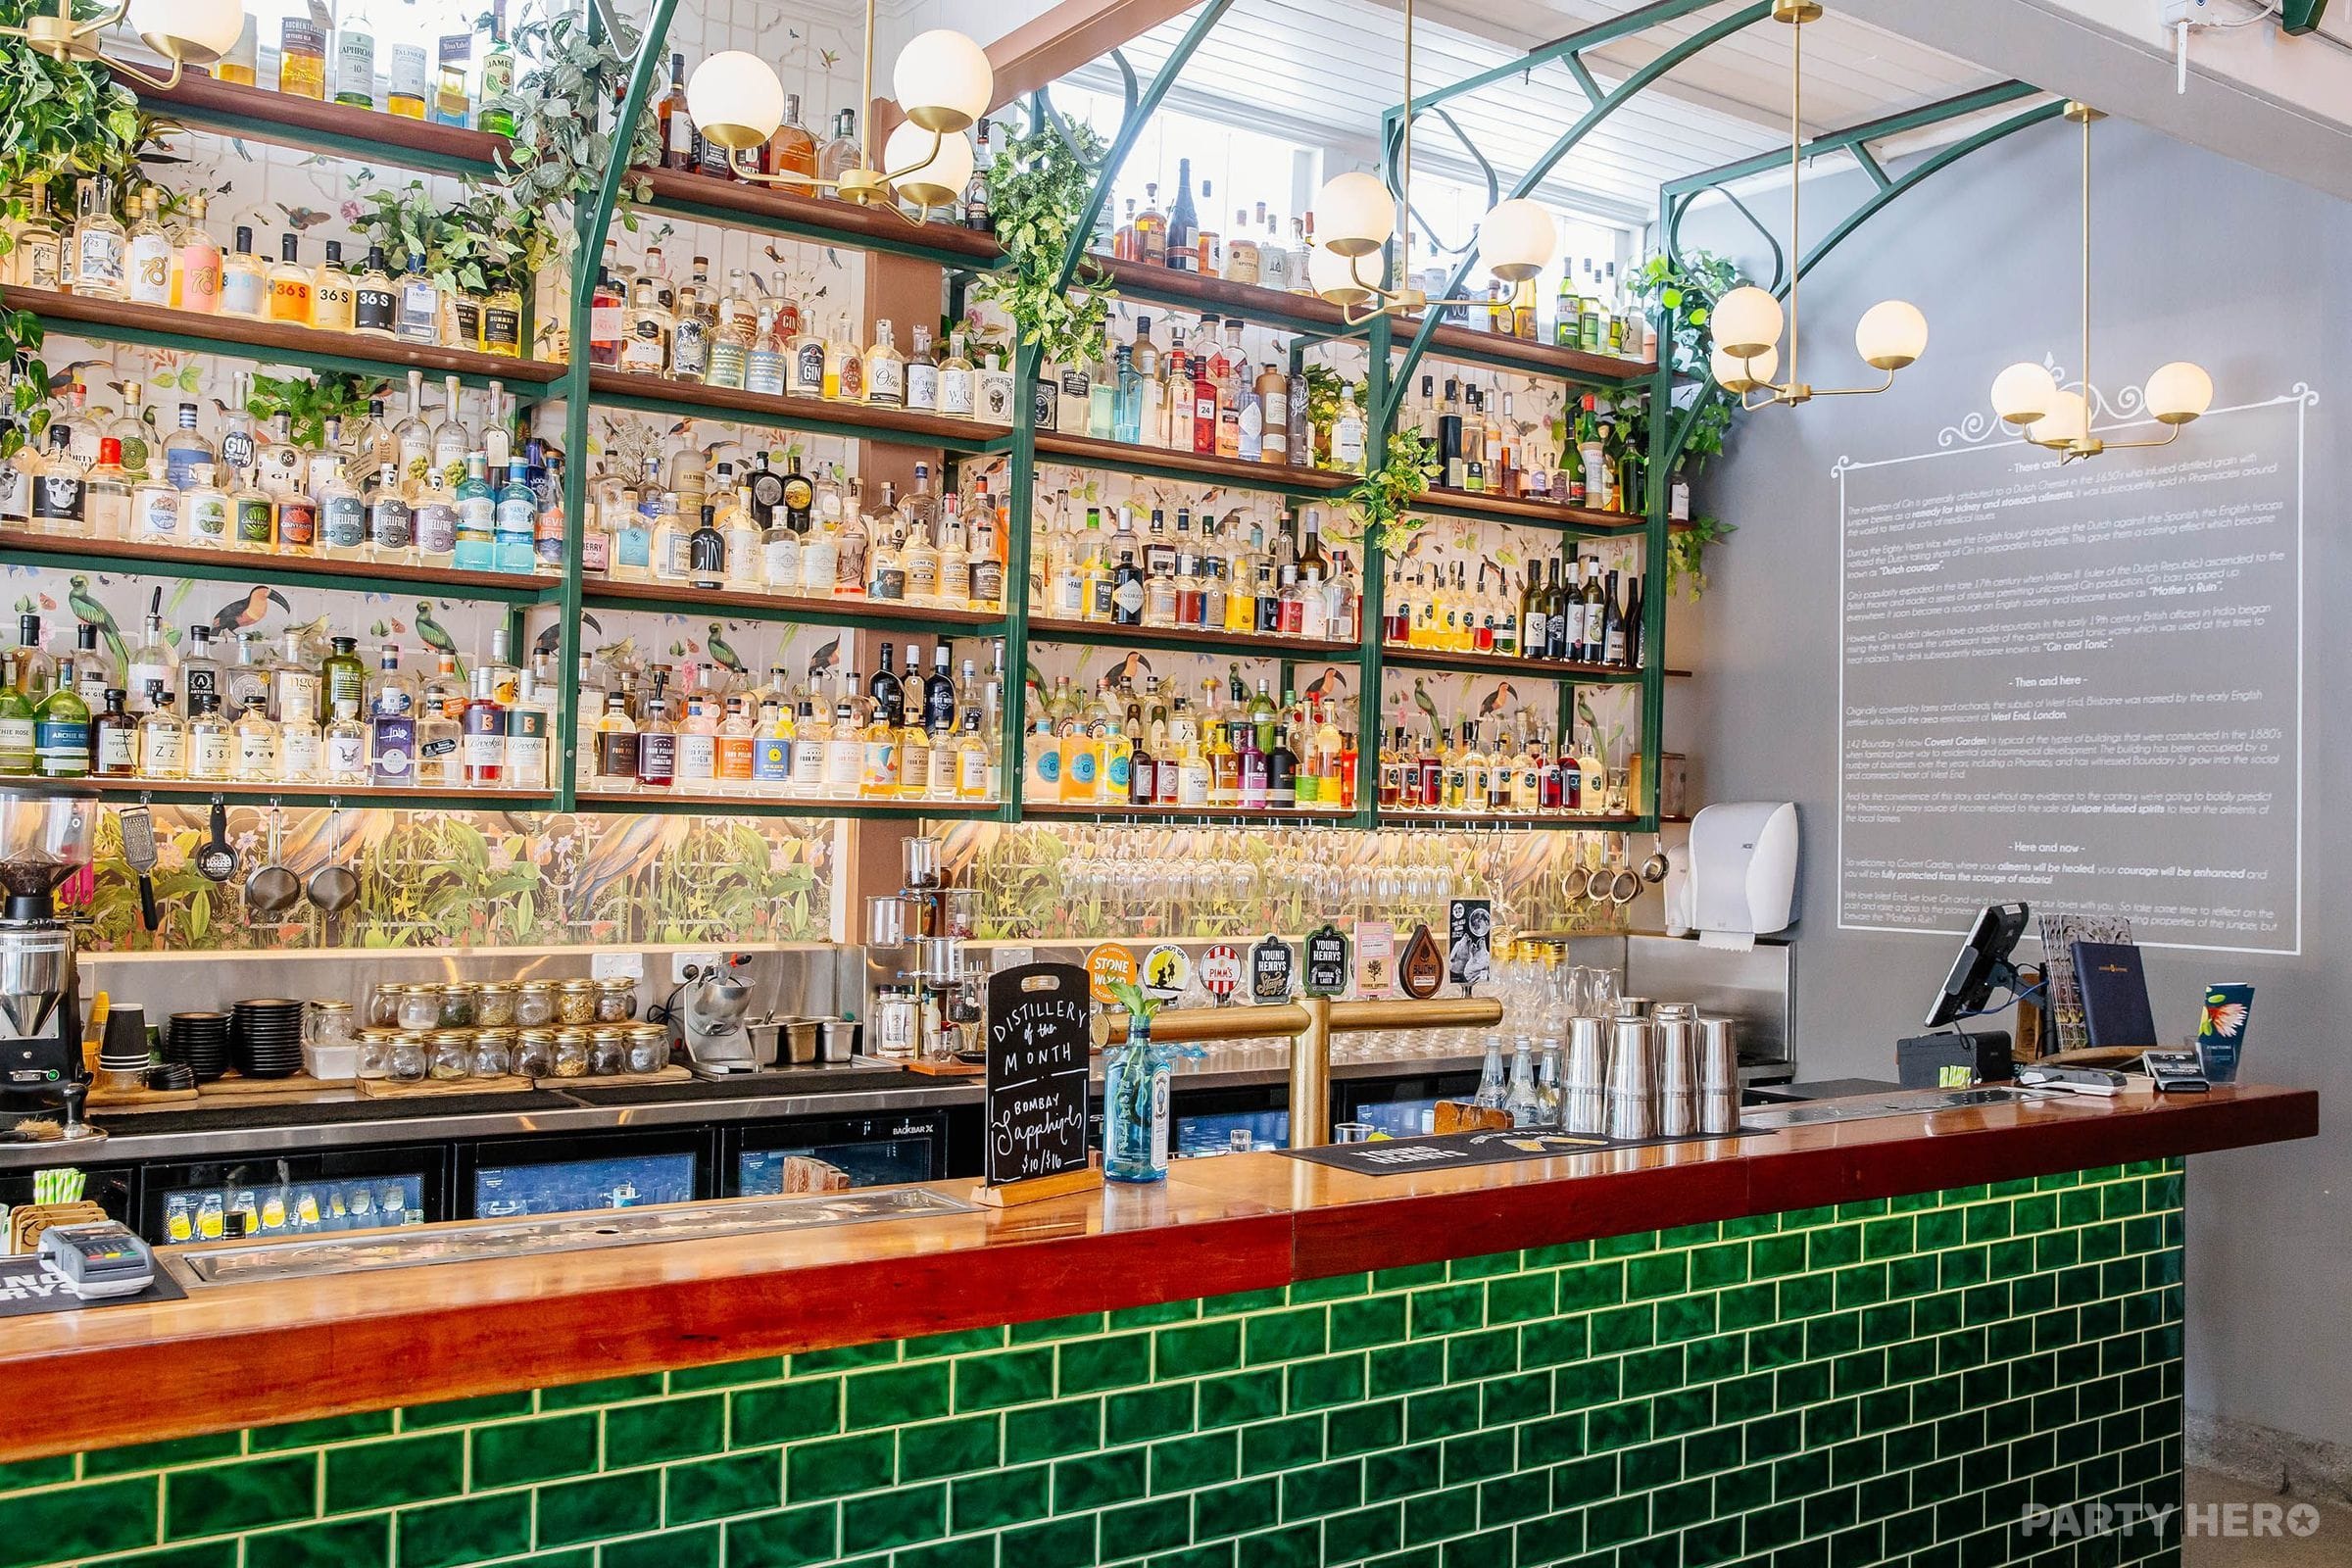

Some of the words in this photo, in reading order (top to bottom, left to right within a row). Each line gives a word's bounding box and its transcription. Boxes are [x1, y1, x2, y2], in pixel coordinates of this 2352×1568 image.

[276, 283, 296, 296] 36
[298, 286, 306, 298] S
[319, 289, 338, 302] 36
[341, 291, 349, 304] S
[359, 292, 378, 306] 36
[379, 294, 389, 307] S
[804, 365, 821, 382] GIN
[224, 436, 253, 457] GIN
[2014, 460, 2038, 473] There
[1911, 507, 1940, 519] remedy
[1941, 505, 1953, 514] for
[1954, 501, 1981, 514] kidney
[1982, 499, 2000, 509] and
[2001, 494, 2036, 507] stomach
[2218, 503, 2250, 516] English
[333, 514, 360, 527] HELLFIRE
[380, 514, 407, 529] HELLFIRE
[426, 519, 453, 532] HELLFIRE
[2234, 513, 2275, 526] became
[2204, 553, 2254, 566] ascended
[2268, 550, 2285, 561] the
[2237, 603, 2271, 615] began
[2063, 641, 2082, 651] and
[2015, 677, 2036, 686] Then
[2038, 676, 2057, 685] and
[2059, 675, 2081, 685] here
[480, 713, 494, 731] B
[1990, 712, 2011, 721] West
[523, 715, 535, 733] B
[1923, 737, 1954, 746] Covent
[2070, 804, 2102, 814] juniper
[2136, 805, 2165, 814] spirits
[2014, 842, 2036, 851] Here
[2038, 843, 2057, 852] and
[1997, 861, 2032, 871] ailments
[2033, 862, 2046, 871] will
[2046, 863, 2061, 872] be
[2117, 867, 2159, 876] courage
[2160, 866, 2176, 875] will
[2176, 867, 2191, 876] be
[2192, 867, 2246, 878] enhanced
[1880, 870, 1896, 880] fully
[1896, 870, 1937, 881] protected
[1957, 872, 1971, 881] the
[1971, 874, 2006, 884] scourge
[1315, 940, 1340, 951] YOUNG
[1260, 950, 1285, 960] YOUNG
[1313, 951, 1341, 961] HENRYS
[1094, 957, 1129, 974] STONE
[1258, 960, 1287, 972] HENRYS
[993, 1000, 1088, 1043] DISTILLERY
[1023, 1022, 1033, 1045] of
[1037, 1022, 1057, 1039] the
[1004, 1042, 1071, 1076] MONTH
[1014, 1093, 1059, 1115] BOMBAY
[1349, 1145, 1444, 1157] YOUNG
[1365, 1151, 1469, 1164] HENRYS
